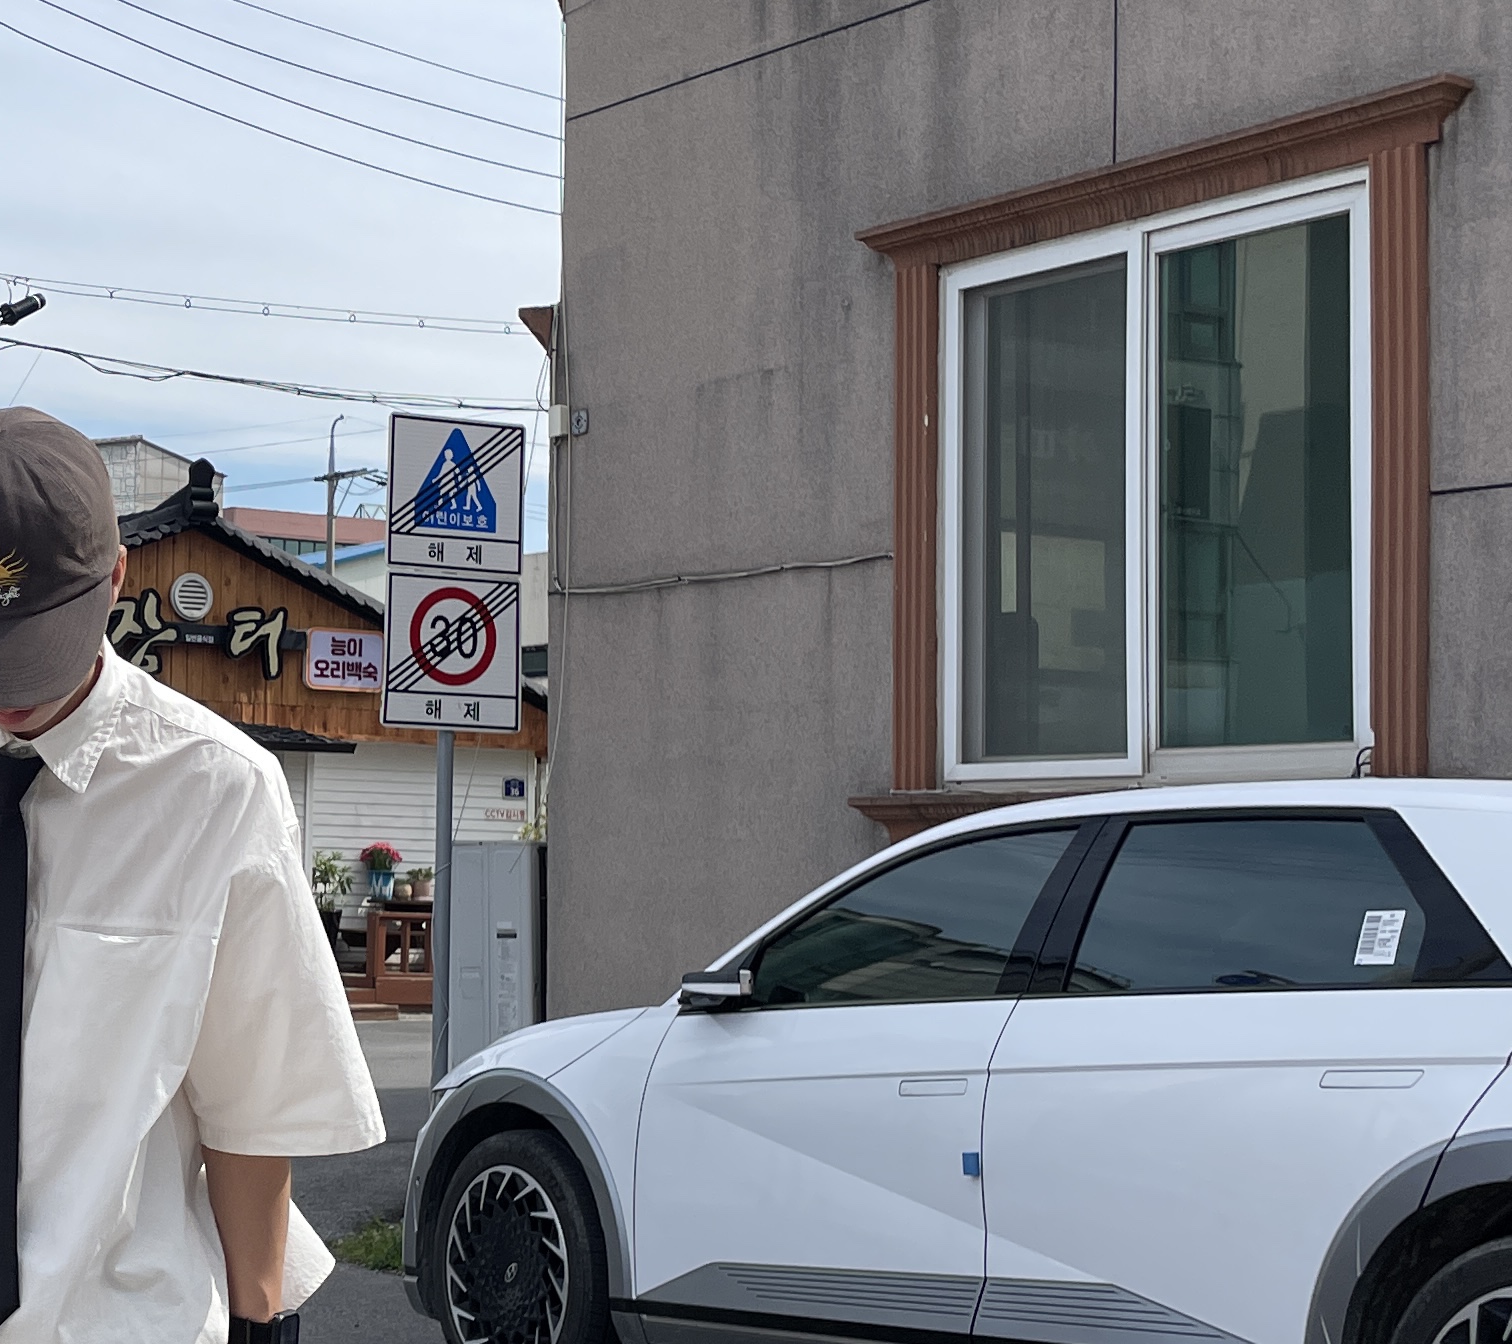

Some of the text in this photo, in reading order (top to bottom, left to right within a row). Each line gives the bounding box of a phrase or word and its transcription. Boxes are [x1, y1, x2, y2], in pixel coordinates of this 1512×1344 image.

[331, 636, 363, 658] 능이
[430, 614, 478, 659] 30
[314, 659, 378, 682] 오리백숙
